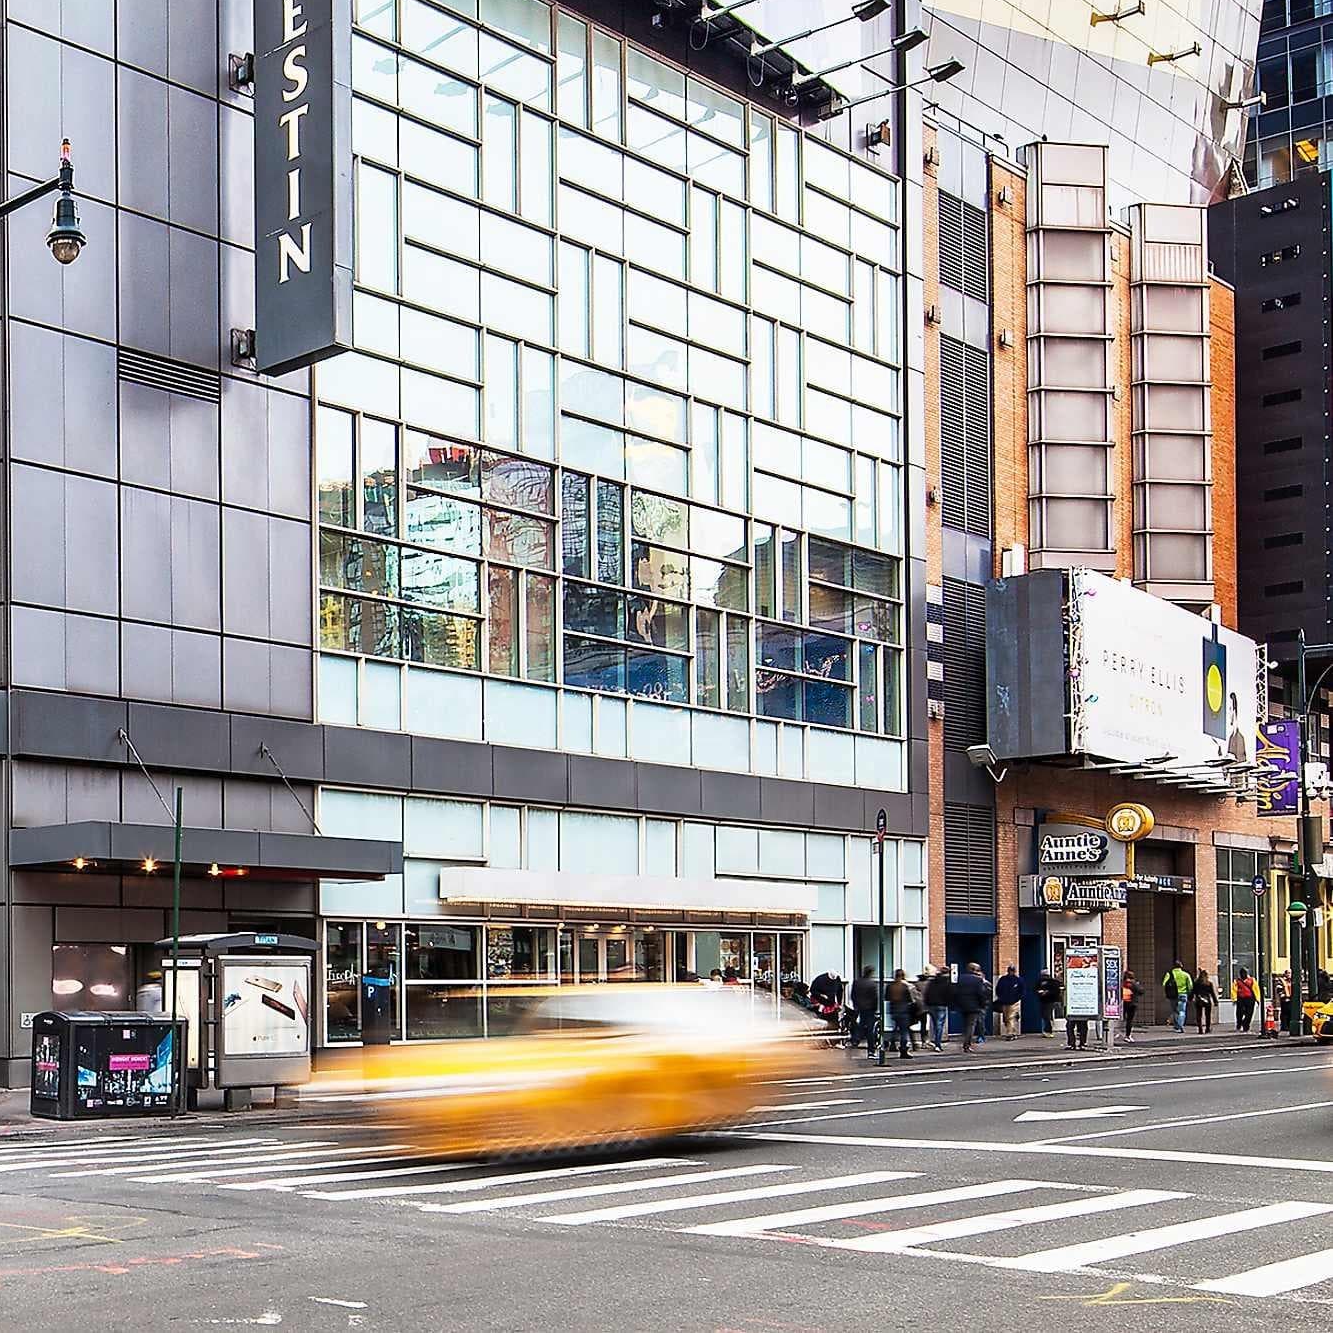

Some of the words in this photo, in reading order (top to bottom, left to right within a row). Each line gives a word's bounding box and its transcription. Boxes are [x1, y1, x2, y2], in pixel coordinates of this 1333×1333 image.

[1041, 833, 1100, 849] Auntie
[1041, 848, 1100, 862] Anne's
[1067, 883, 1109, 900] Auntie
